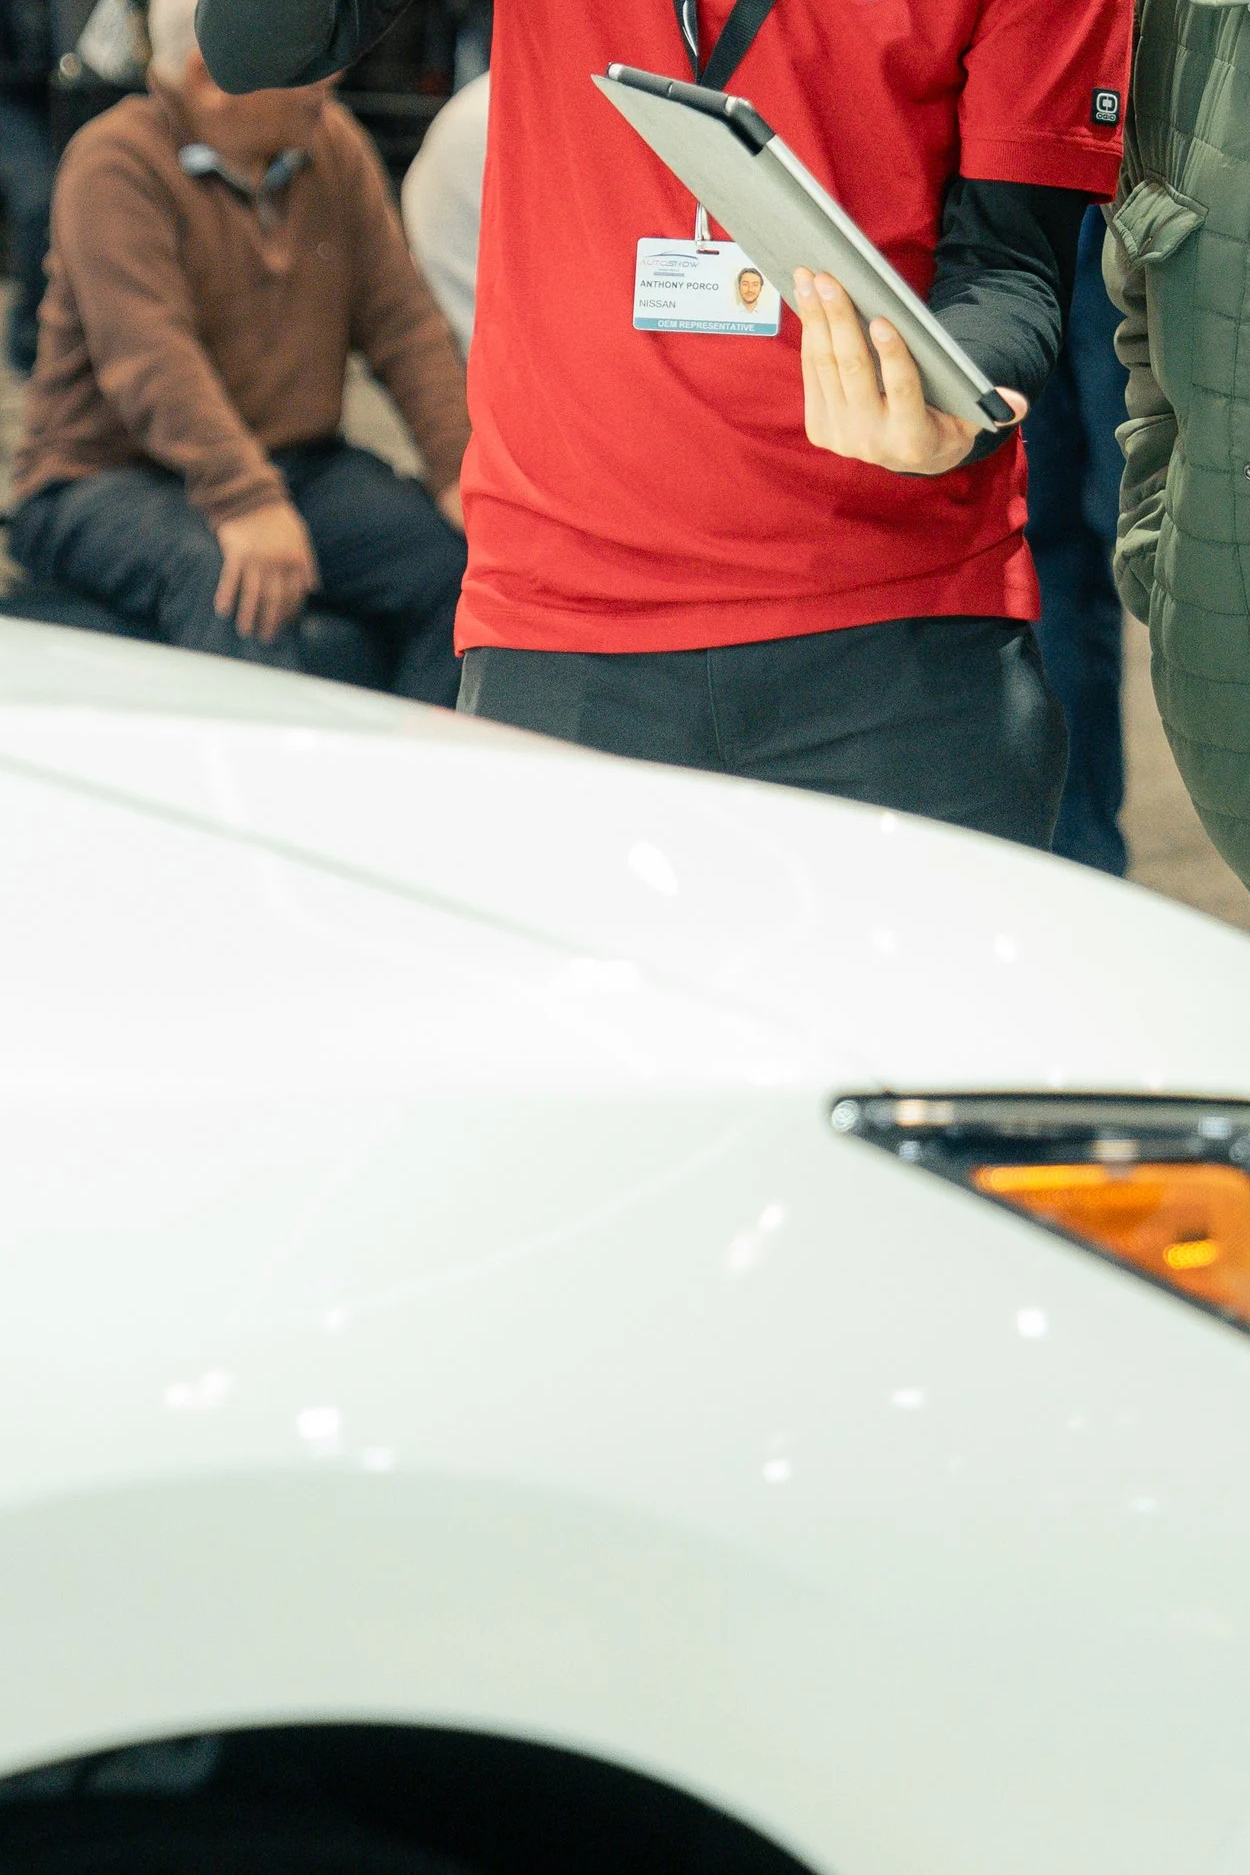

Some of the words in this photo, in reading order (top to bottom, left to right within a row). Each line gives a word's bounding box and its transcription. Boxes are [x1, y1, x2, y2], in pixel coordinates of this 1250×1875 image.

[640, 279, 684, 289] ANTHONY
[686, 281, 719, 291] PORCO
[639, 299, 676, 309] NISSAN
[657, 319, 679, 328] OEM
[679, 321, 755, 332] REPRESENTATIVE
